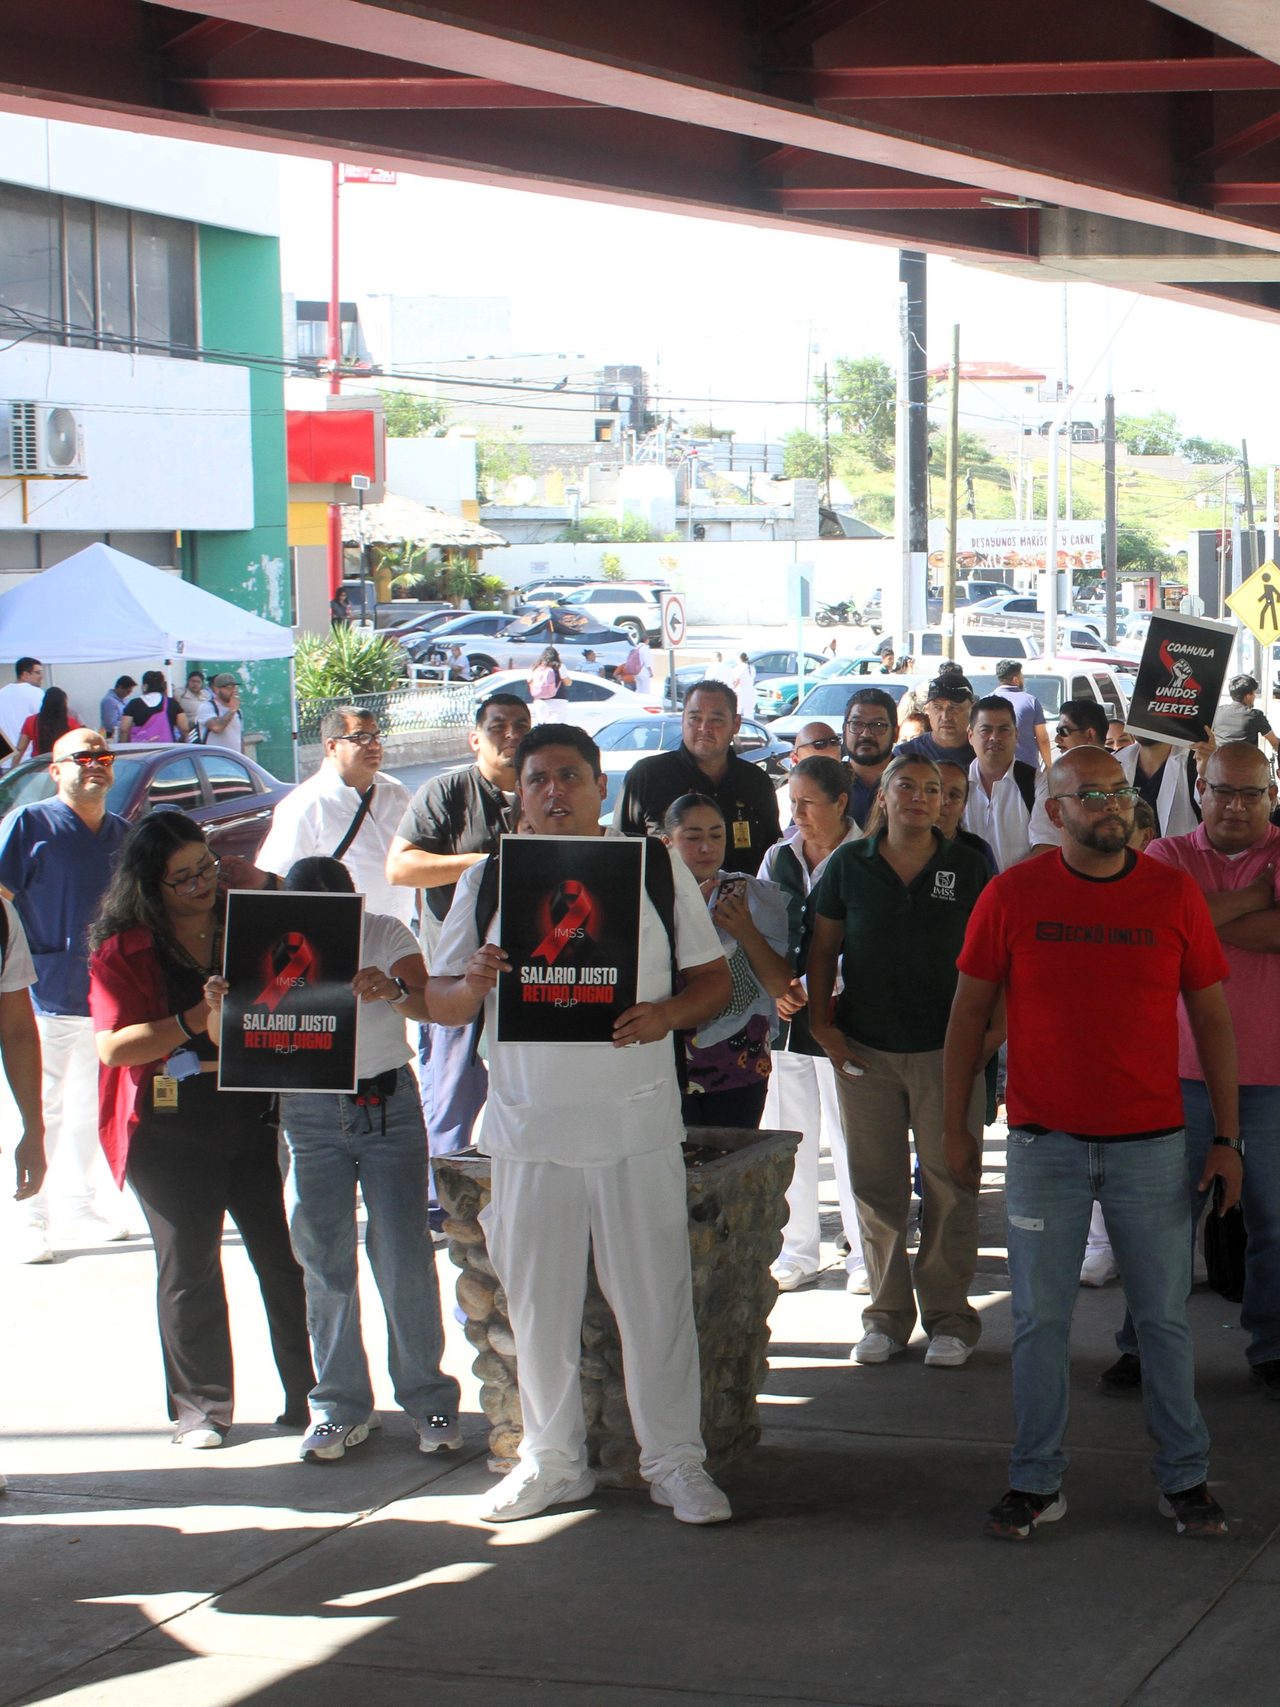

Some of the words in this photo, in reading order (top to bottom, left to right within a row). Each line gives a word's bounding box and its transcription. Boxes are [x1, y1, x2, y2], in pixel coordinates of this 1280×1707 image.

[971, 536, 1017, 548] DESAYUNOS
[1020, 535, 1048, 547] MARISC
[1070, 534, 1094, 545] CARNE
[1166, 643, 1215, 658] COAHUILA
[1155, 687, 1197, 699] UNIDOS
[1147, 701, 1199, 716] FUERTES
[933, 886, 955, 897] IMSS
[554, 927, 585, 938] IMSS
[276, 976, 305, 987] IMSS
[520, 966, 576, 984] SALARIO
[578, 967, 618, 984] JUSTO
[523, 985, 570, 1003] RETIRO
[573, 985, 614, 1003] DIGNO
[554, 998, 578, 1008] RJP
[243, 1013, 296, 1031] SALARIO
[299, 1014, 337, 1032] JUSTO
[244, 1031, 289, 1049] RETIRO
[293, 1032, 333, 1050] DIGNO
[275, 1044, 299, 1054] RJP
